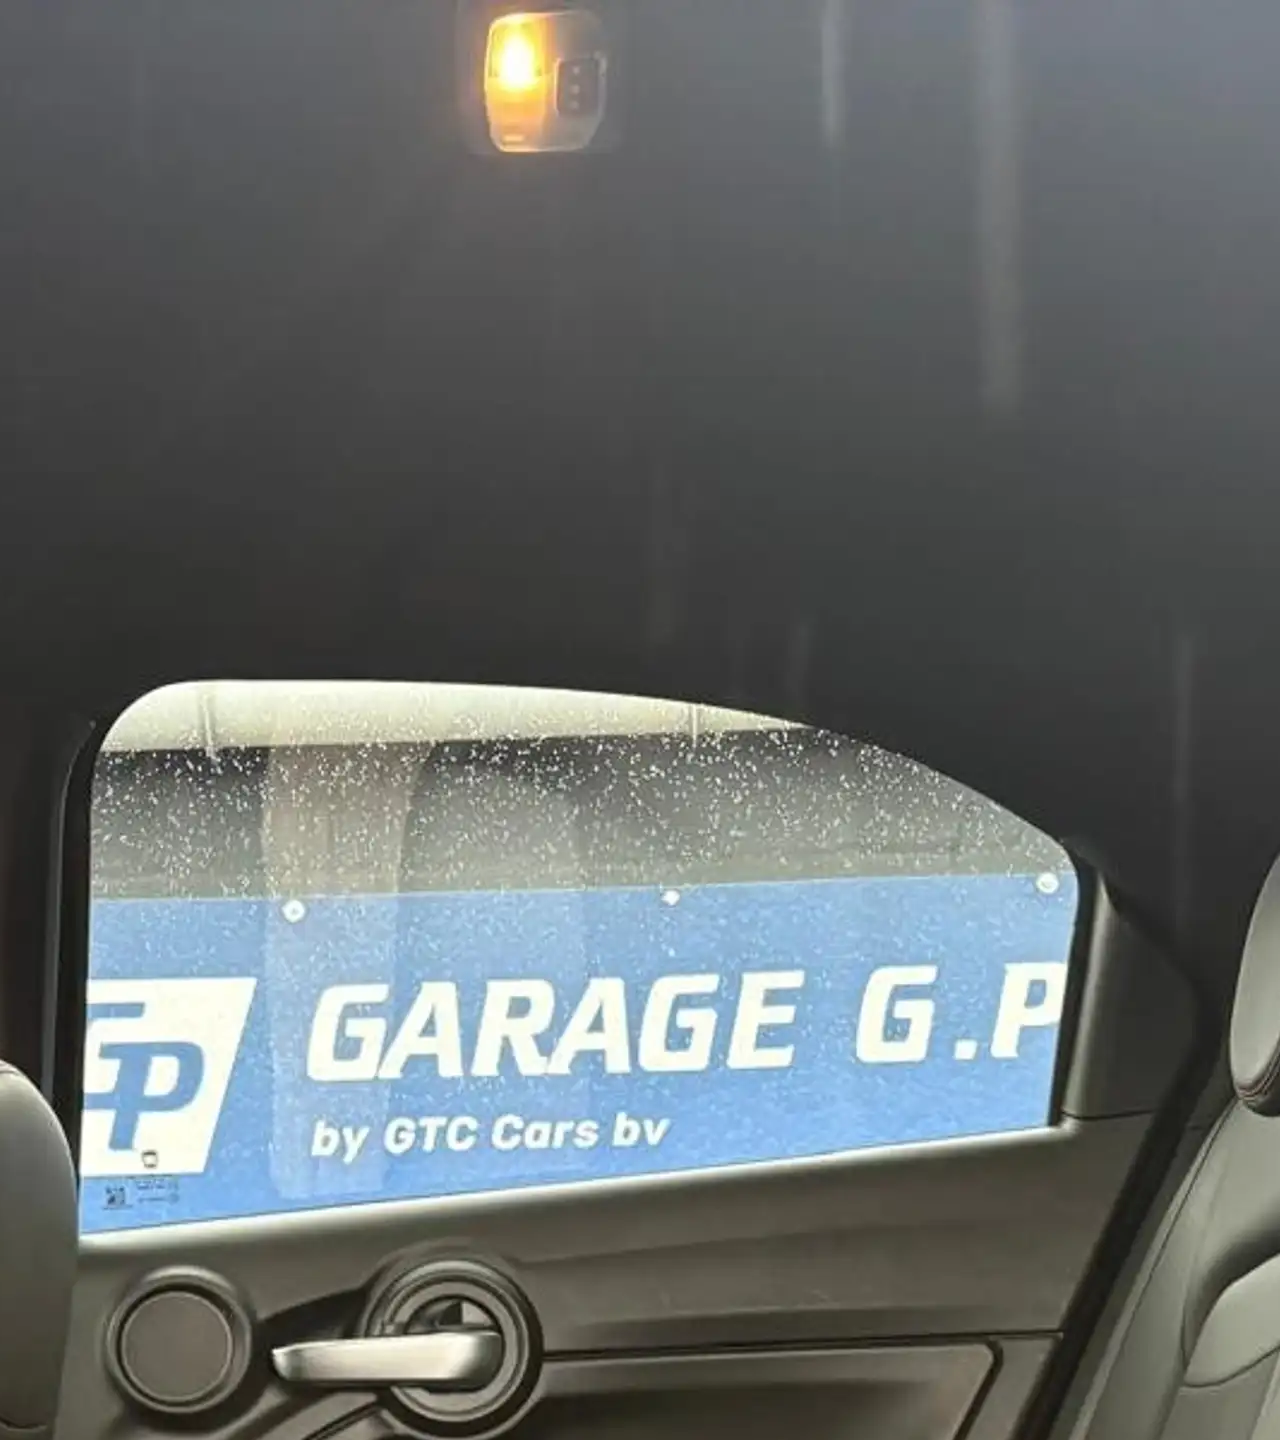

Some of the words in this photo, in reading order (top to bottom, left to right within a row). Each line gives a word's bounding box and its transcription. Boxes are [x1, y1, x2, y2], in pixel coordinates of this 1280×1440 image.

[308, 970, 805, 1081] GARAGE
[312, 1122, 369, 1163] by
[385, 1117, 478, 1152] GTC
[492, 1113, 599, 1149] Cars
[613, 1112, 670, 1147] bv
